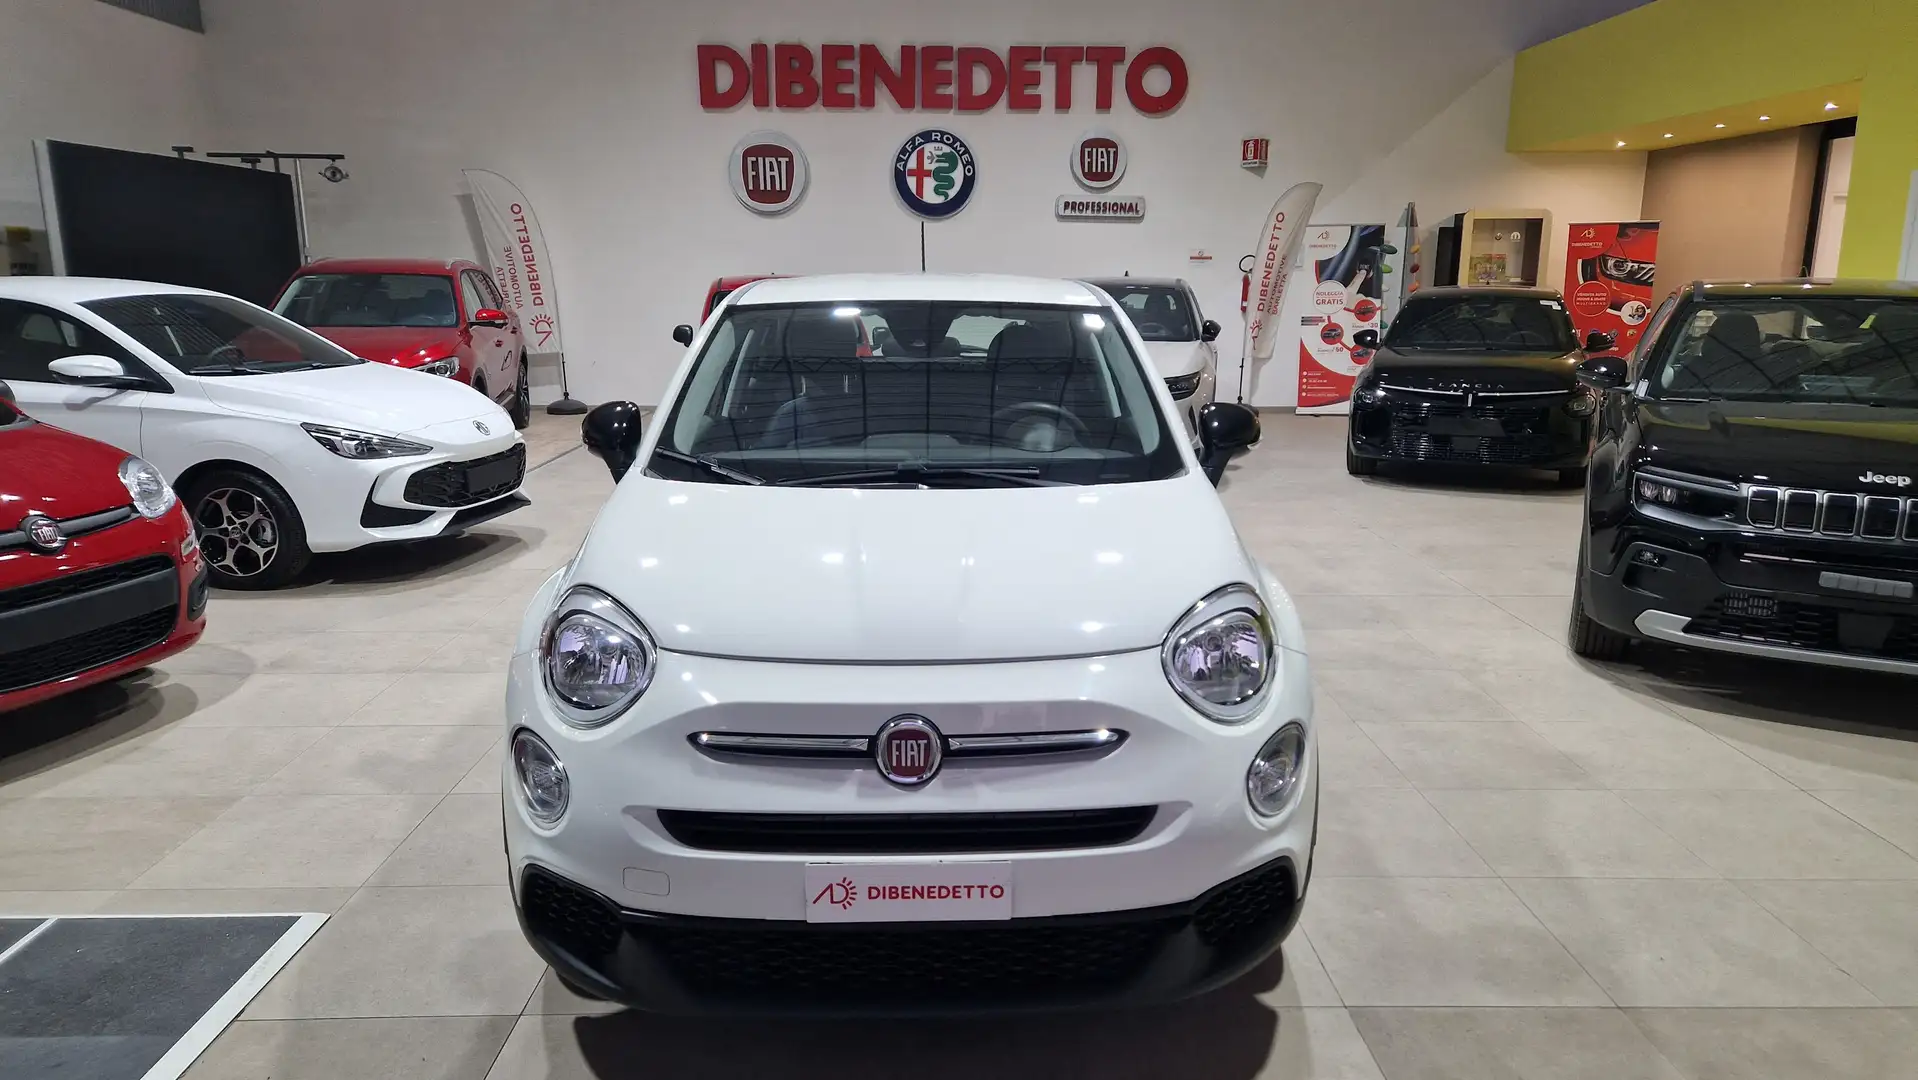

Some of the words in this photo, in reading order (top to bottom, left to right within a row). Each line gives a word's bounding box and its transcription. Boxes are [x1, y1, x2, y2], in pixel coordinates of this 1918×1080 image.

[697, 43, 1189, 114] DIBENEDETTO
[897, 136, 924, 171] ALFA
[931, 132, 973, 176] ROMEO
[1084, 147, 1117, 173] FIAT
[747, 155, 790, 192] FIAT
[1063, 200, 1141, 215] PROFESSIONAL
[1257, 211, 1286, 312] DIBENEDETTO
[1267, 254, 1288, 314] AUTOMOTIVE
[1272, 272, 1288, 315] BARLETTA
[1315, 298, 1344, 306] GRATIS
[1859, 470, 1911, 487] Jeep
[37, 525, 57, 541] FIAT
[892, 740, 927, 767] FIAT
[868, 885, 1004, 900] DIBENEDETTO
